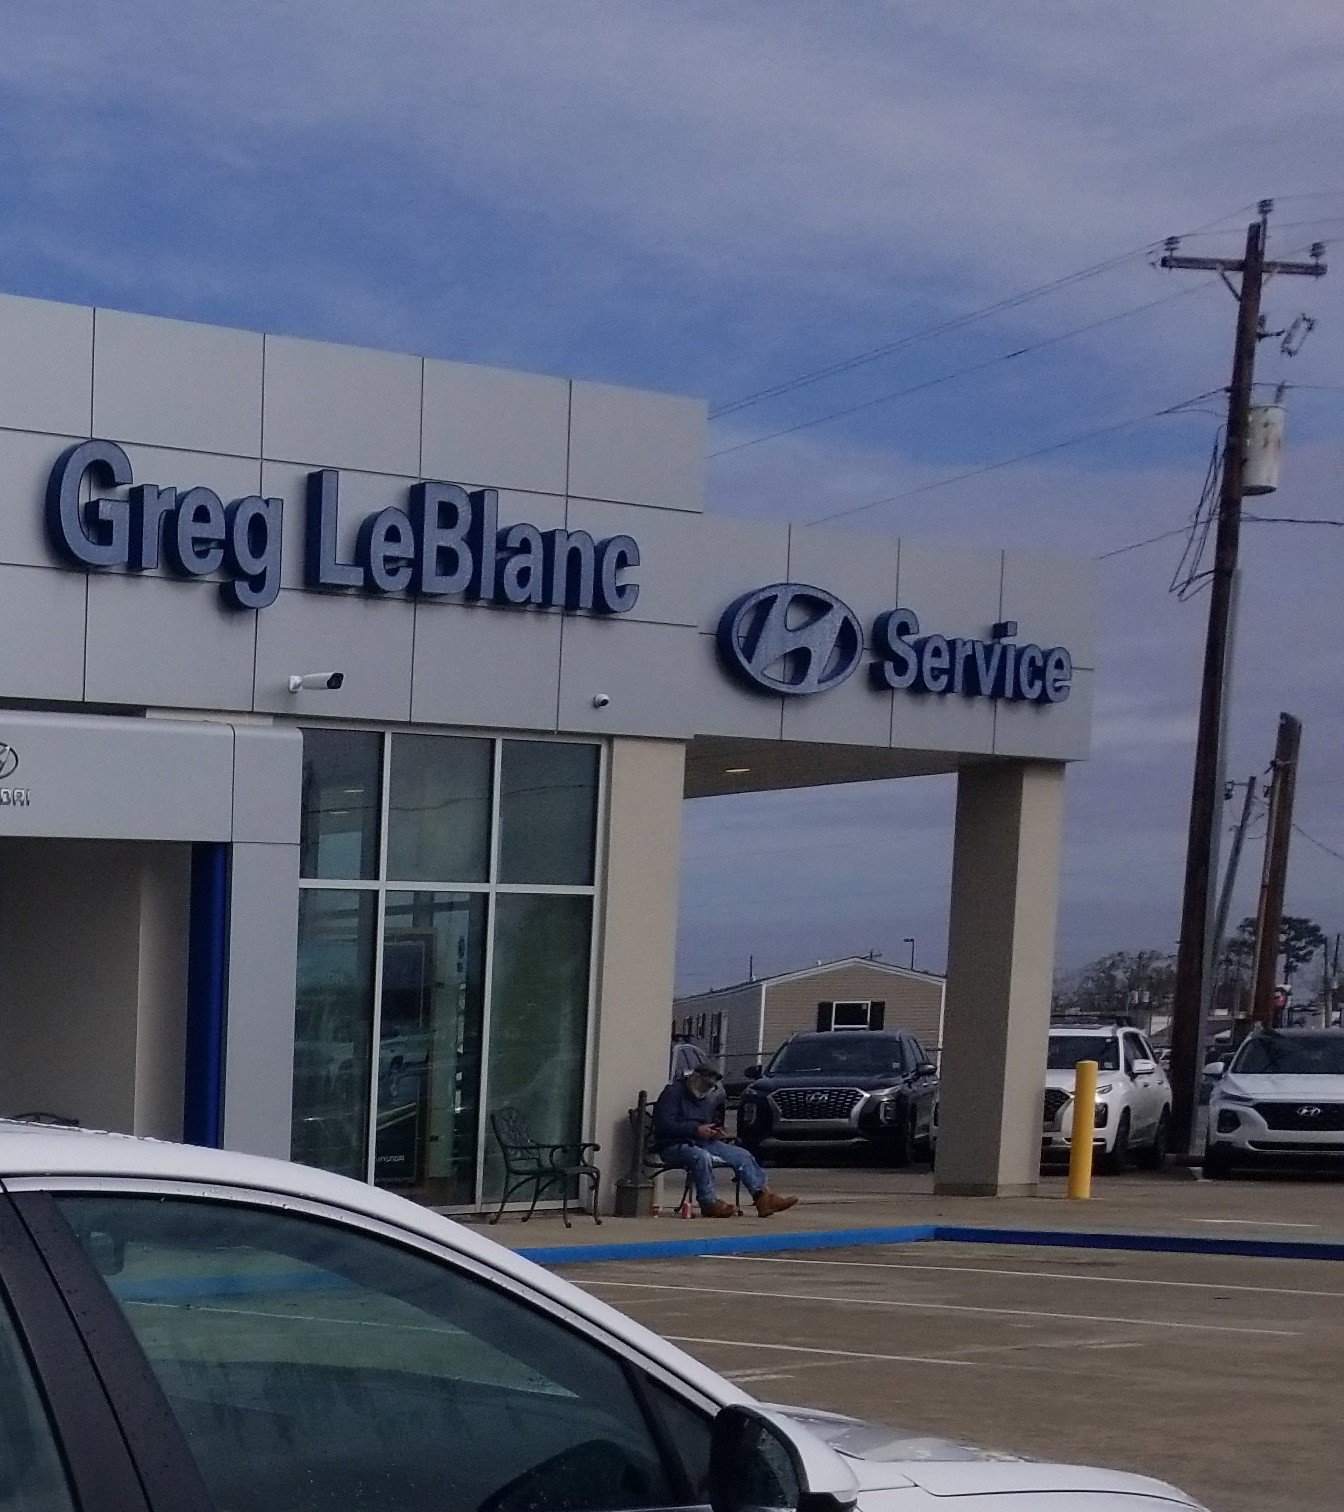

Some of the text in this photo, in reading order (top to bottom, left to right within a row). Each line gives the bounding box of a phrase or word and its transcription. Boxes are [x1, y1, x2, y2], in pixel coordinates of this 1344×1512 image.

[45, 438, 641, 613] Greg LeBlanc
[868, 608, 1072, 702] Service
